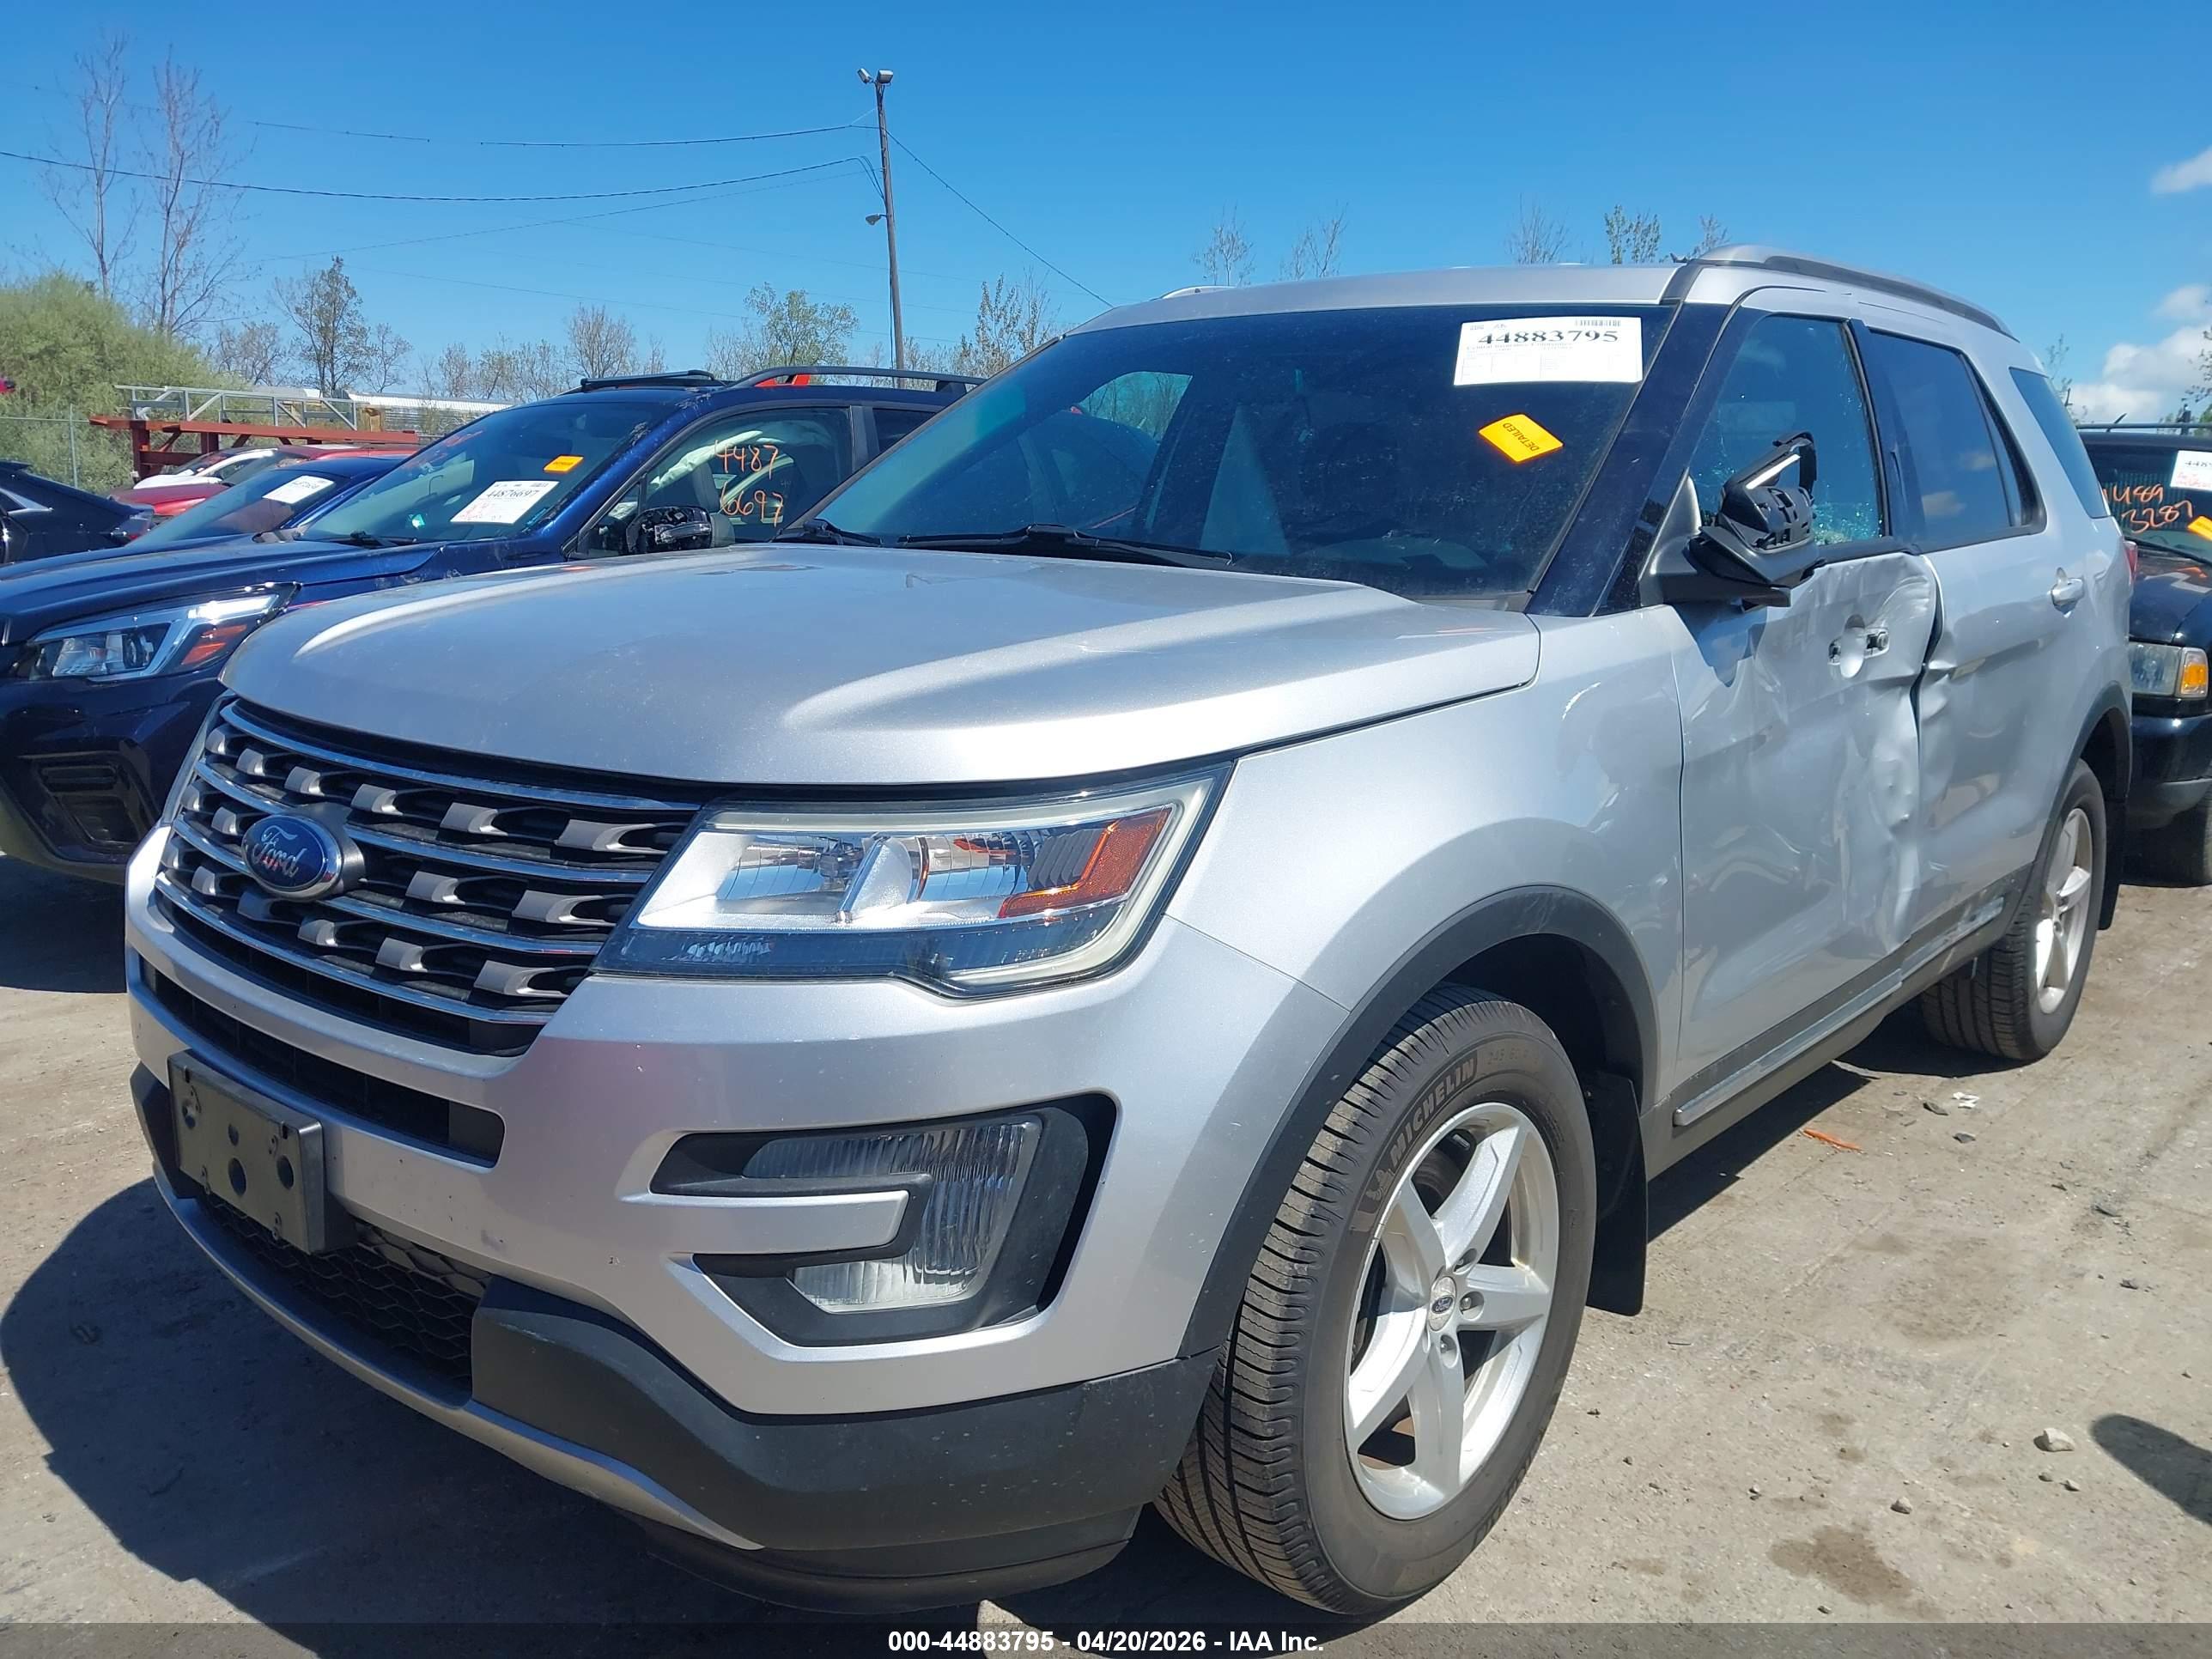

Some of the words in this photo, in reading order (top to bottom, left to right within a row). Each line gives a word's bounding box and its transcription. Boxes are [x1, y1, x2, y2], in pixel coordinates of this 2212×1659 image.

[1478, 330, 1619, 344] 44883795
[1503, 422, 1540, 452] DETAILED
[714, 440, 778, 480] 4487
[720, 481, 783, 527] 6697
[2121, 500, 2192, 533] 3287
[252, 824, 307, 878] Ford
[1389, 1058, 1474, 1166] MICHELIN
